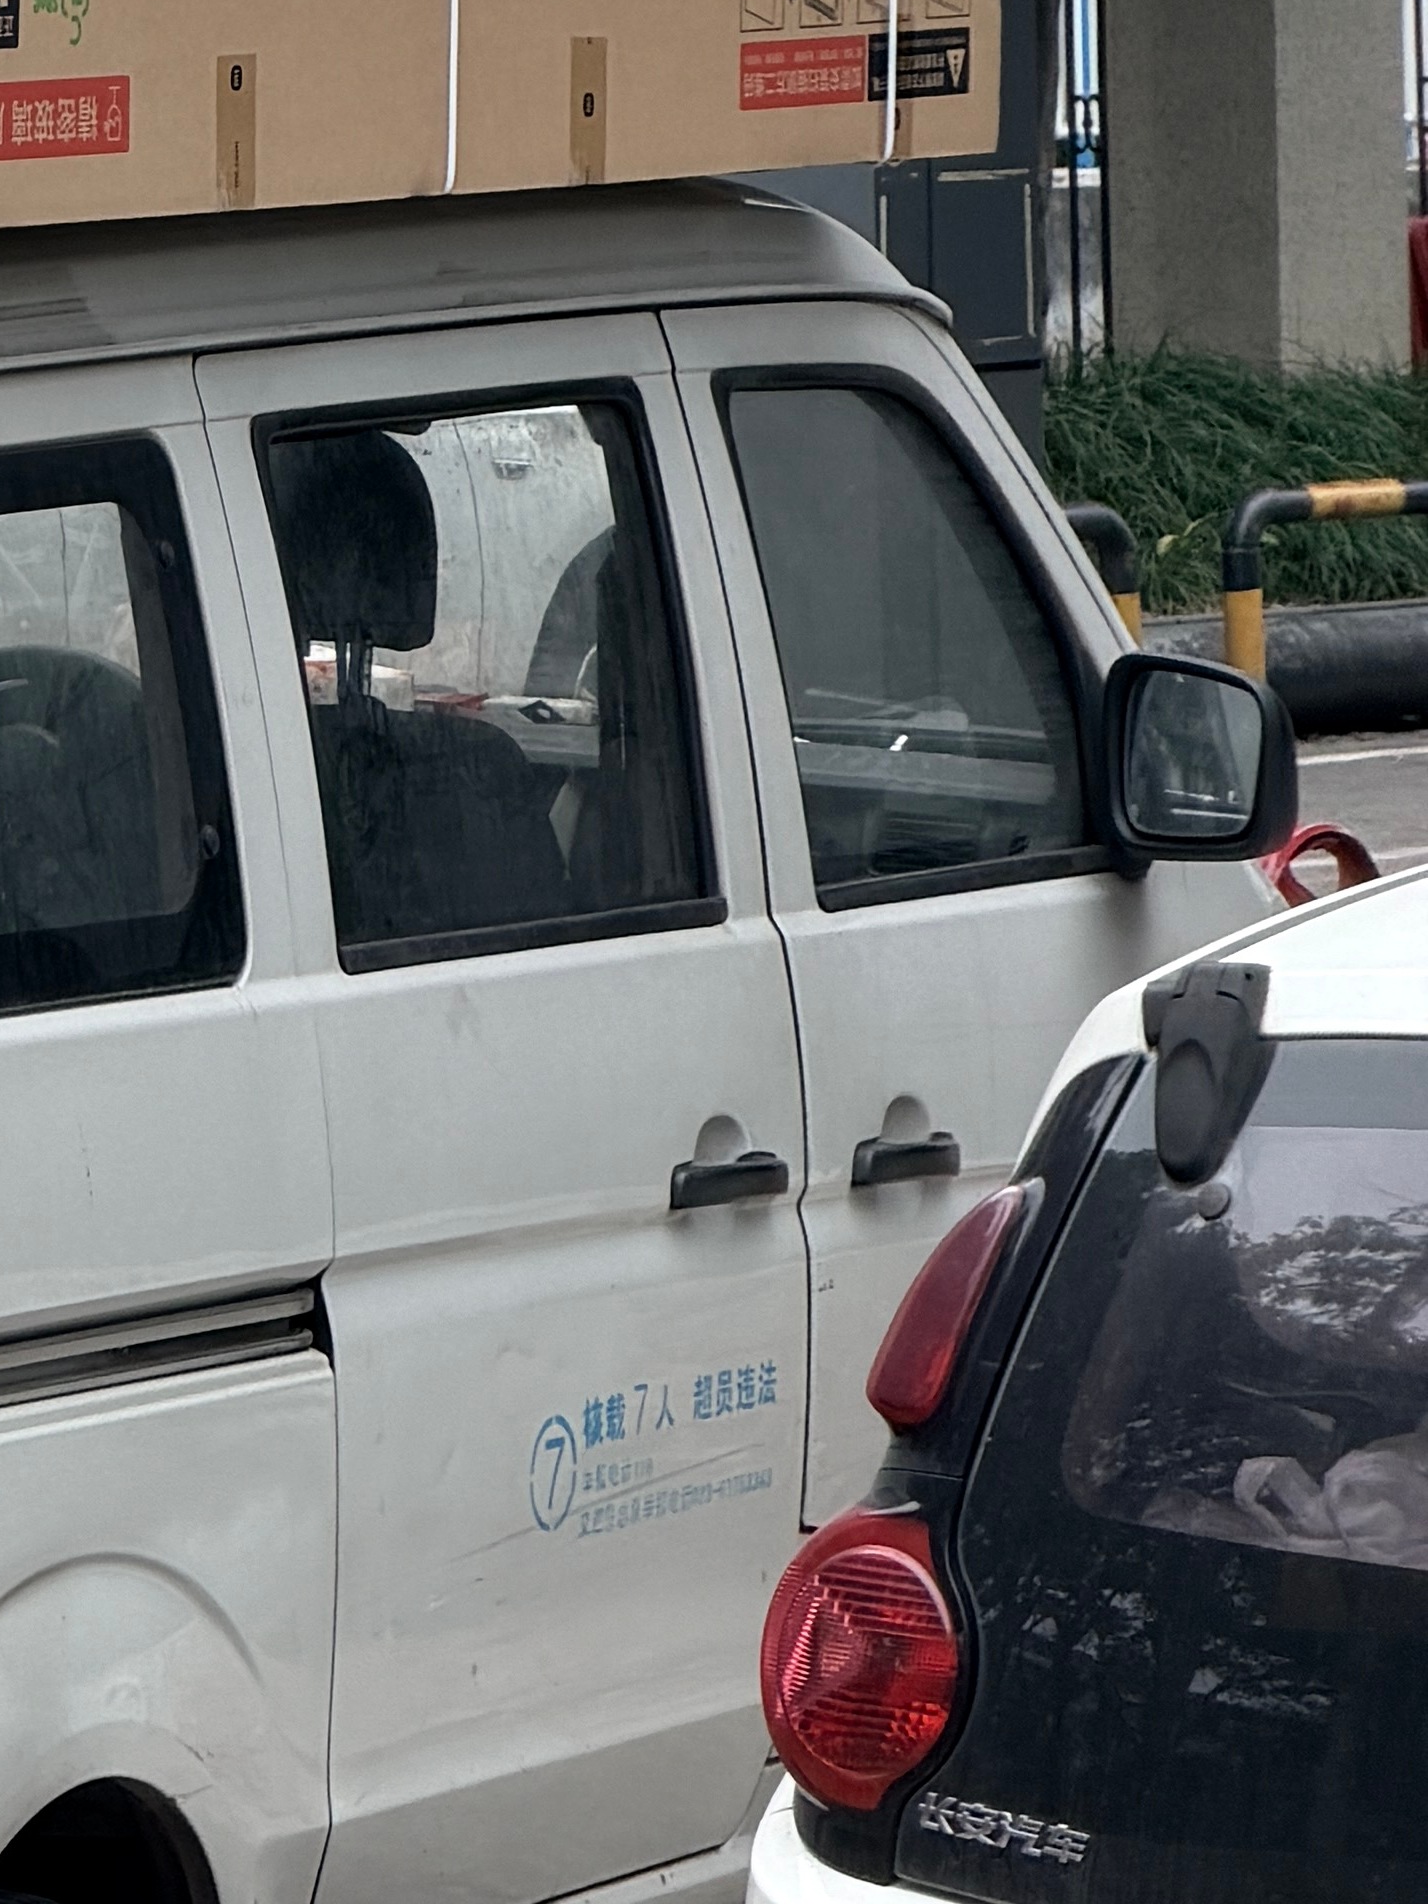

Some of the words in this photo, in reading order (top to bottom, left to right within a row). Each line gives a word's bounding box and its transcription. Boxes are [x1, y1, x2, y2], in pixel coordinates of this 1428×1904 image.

[11, 95, 99, 147] 精密玻璃
[693, 1359, 778, 1421] 超员违法
[917, 1791, 1091, 1865] 长安汽车
